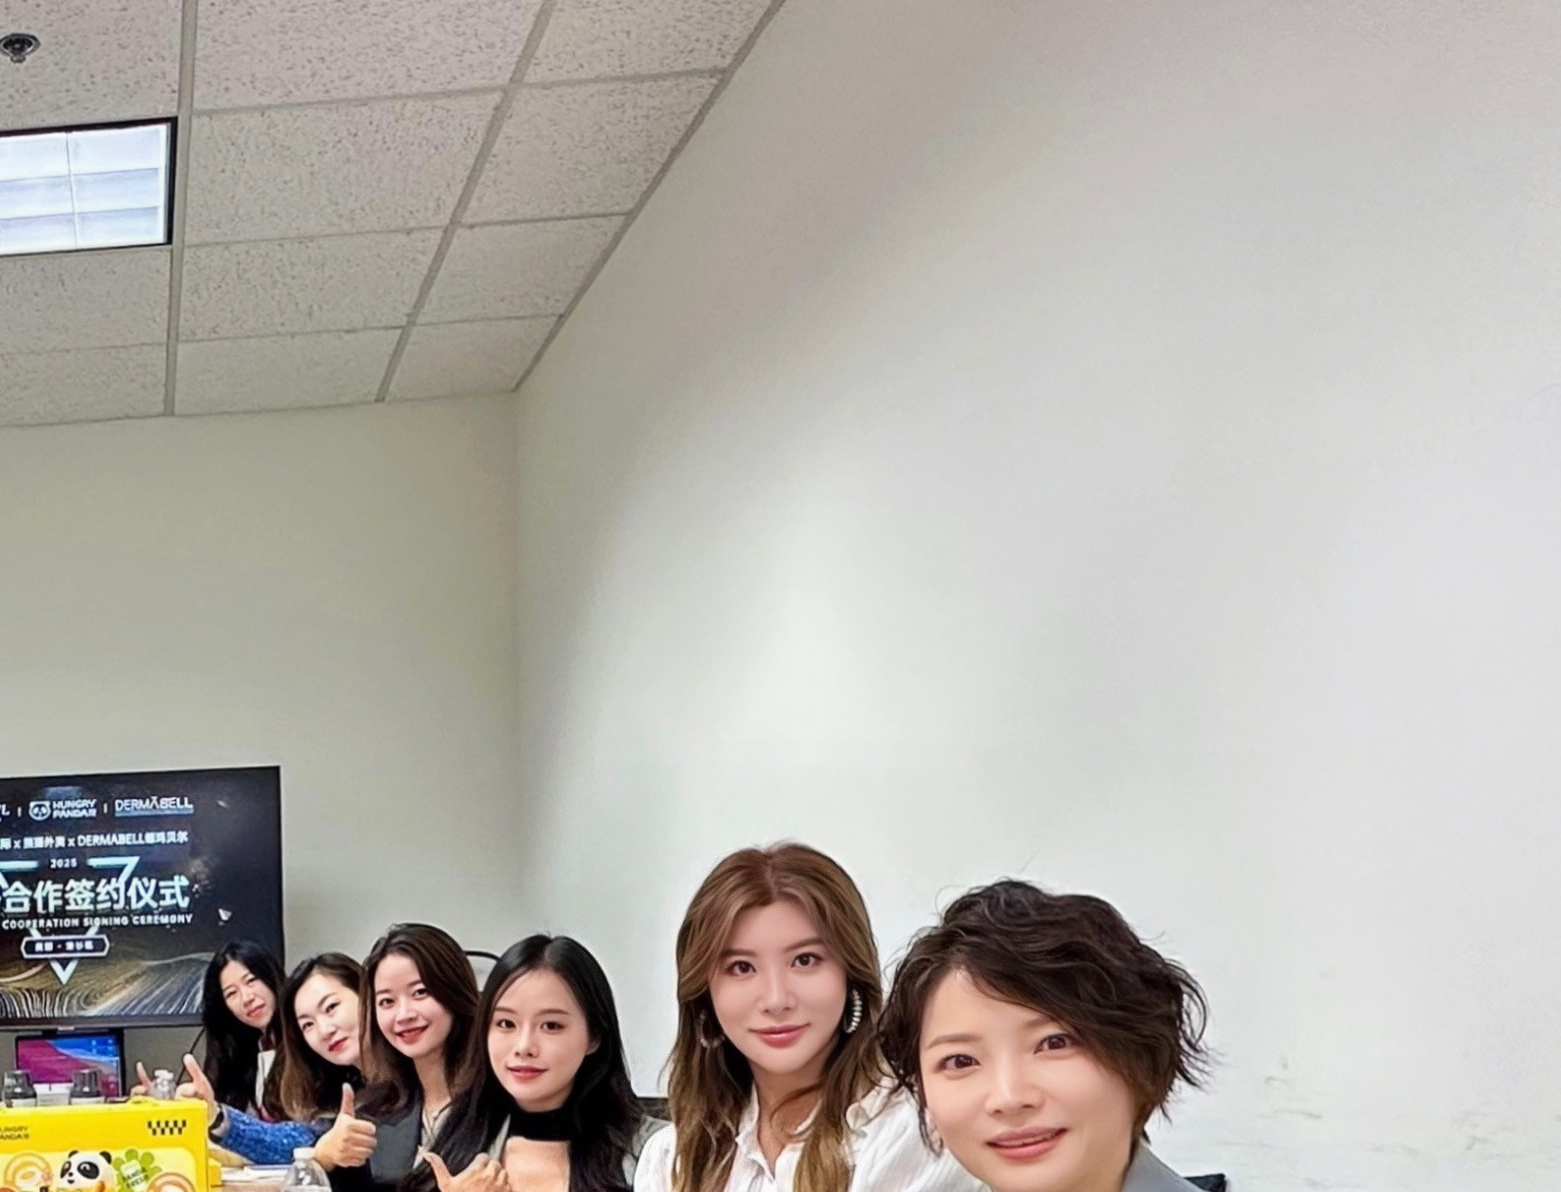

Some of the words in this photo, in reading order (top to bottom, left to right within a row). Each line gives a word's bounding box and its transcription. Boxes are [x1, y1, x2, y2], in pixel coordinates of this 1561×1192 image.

[52, 799, 97, 809] HUNGRY
[49, 858, 77, 869] 2025
[1, 919, 80, 930] COOPERATION
[82, 917, 129, 927] SIGNING
[131, 914, 193, 926] CEREMONY
